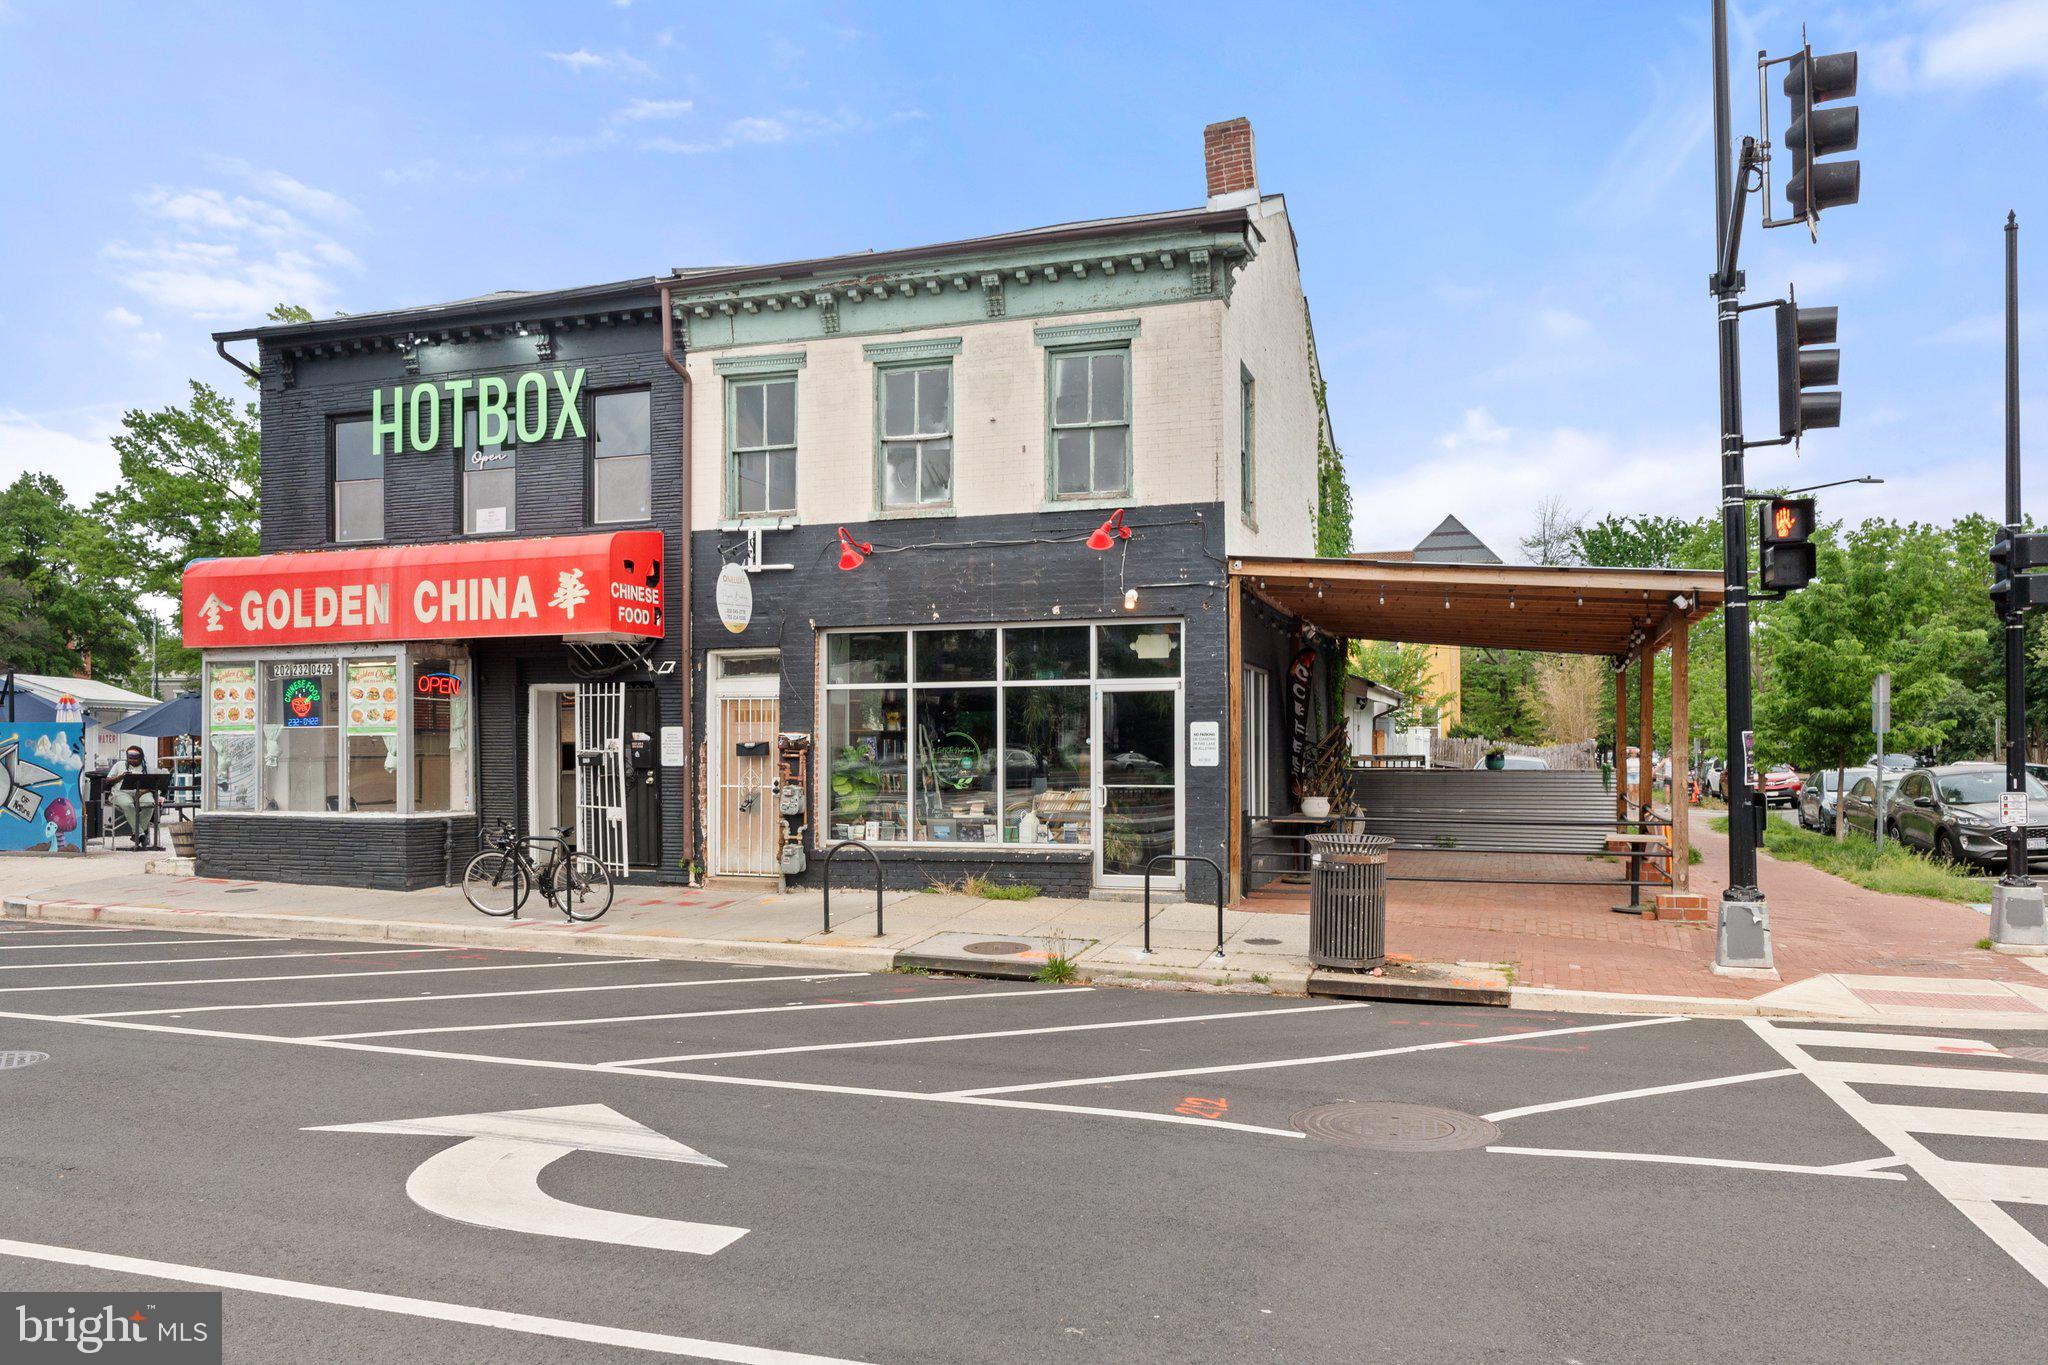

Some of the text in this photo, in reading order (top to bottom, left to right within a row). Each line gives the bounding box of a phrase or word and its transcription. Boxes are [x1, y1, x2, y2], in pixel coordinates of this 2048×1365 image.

[372, 368, 587, 456] HOTBOX
[471, 450, 508, 470] Open
[240, 575, 538, 632] GOLDEN CHINA
[547, 567, 590, 620] 華
[610, 581, 660, 605] CHINESE
[618, 605, 650, 625] FOOD
[274, 663, 333, 676] 202 232 0422
[284, 679, 320, 703] CHINESE FOOD
[418, 675, 460, 695] OPEN
[288, 717, 319, 727] 232-0422
